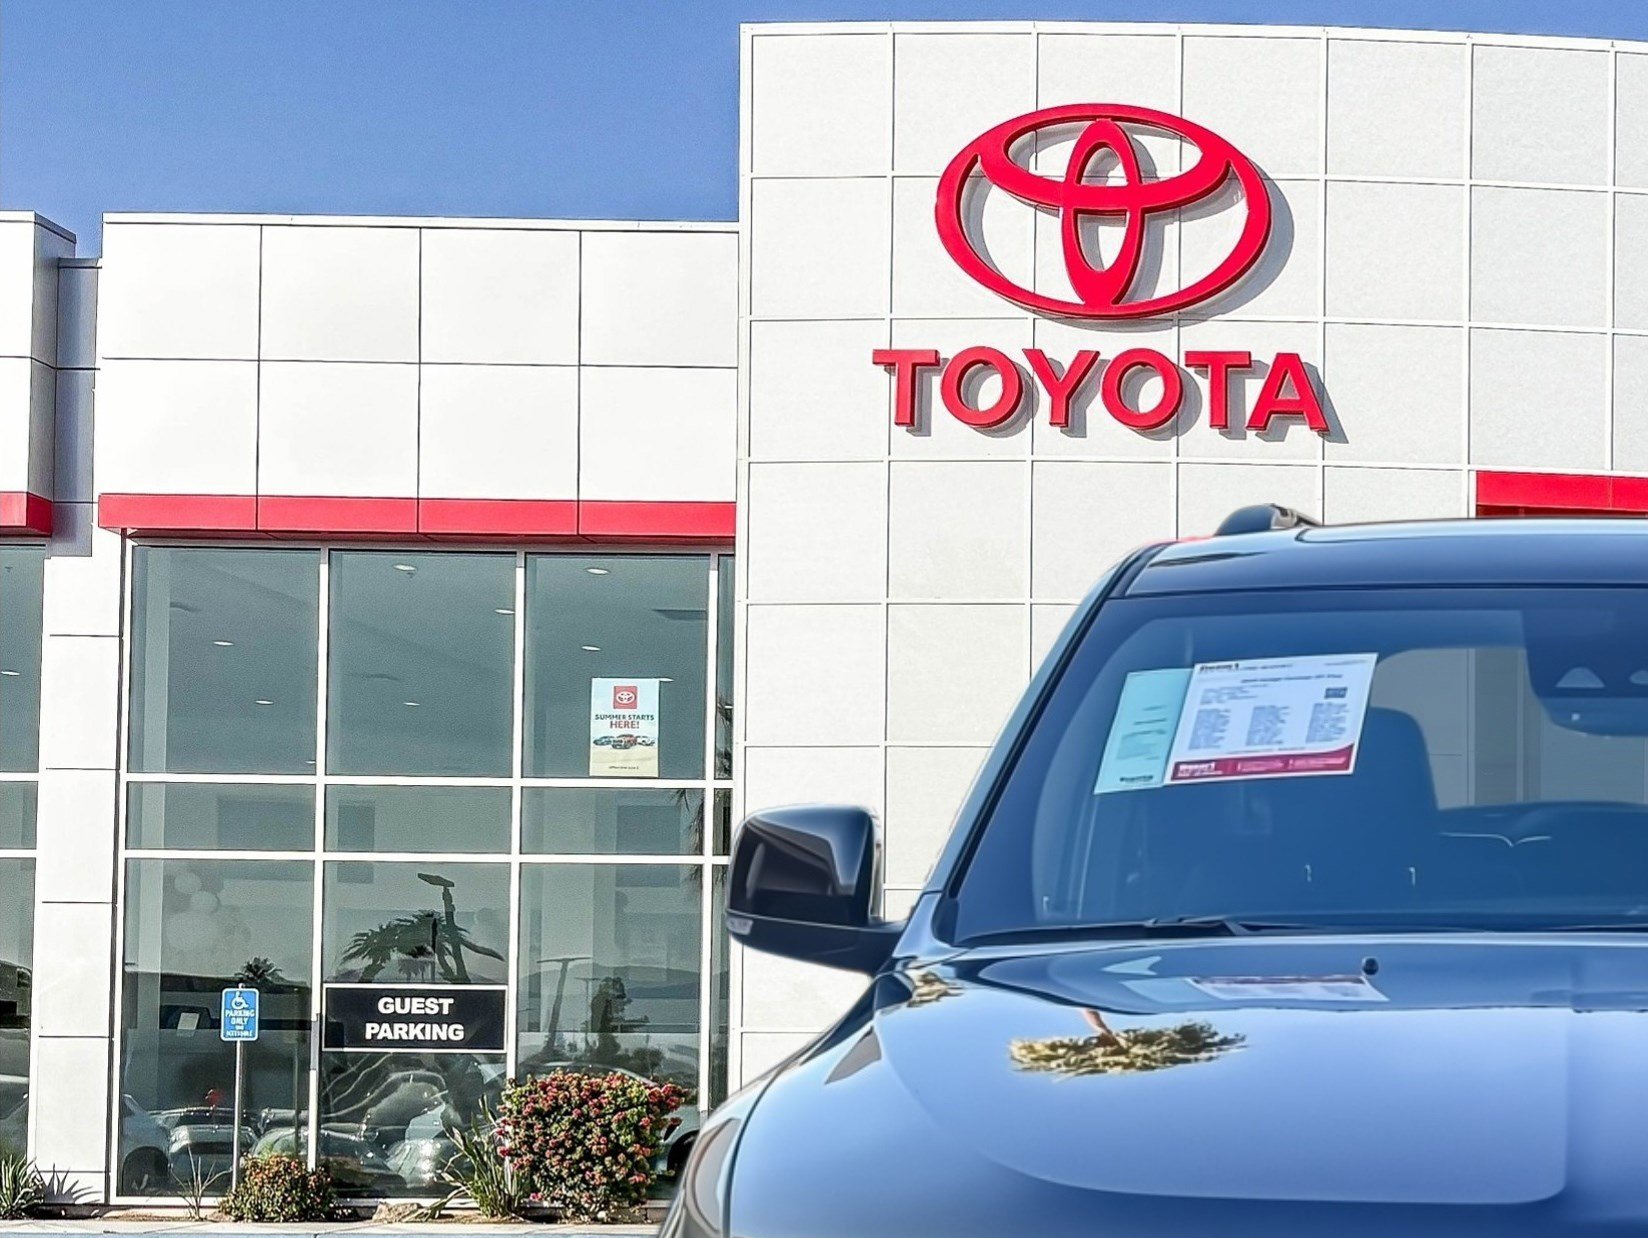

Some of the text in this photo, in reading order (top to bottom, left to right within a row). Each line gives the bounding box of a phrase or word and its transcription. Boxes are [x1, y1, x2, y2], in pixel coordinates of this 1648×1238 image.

[872, 345, 1328, 434] TOYOTA
[609, 720, 640, 729] HERE!
[377, 997, 454, 1015] GUEST
[225, 1009, 255, 1017] PARKING
[230, 1017, 249, 1025] ONLY
[365, 1023, 465, 1041] PARKING
